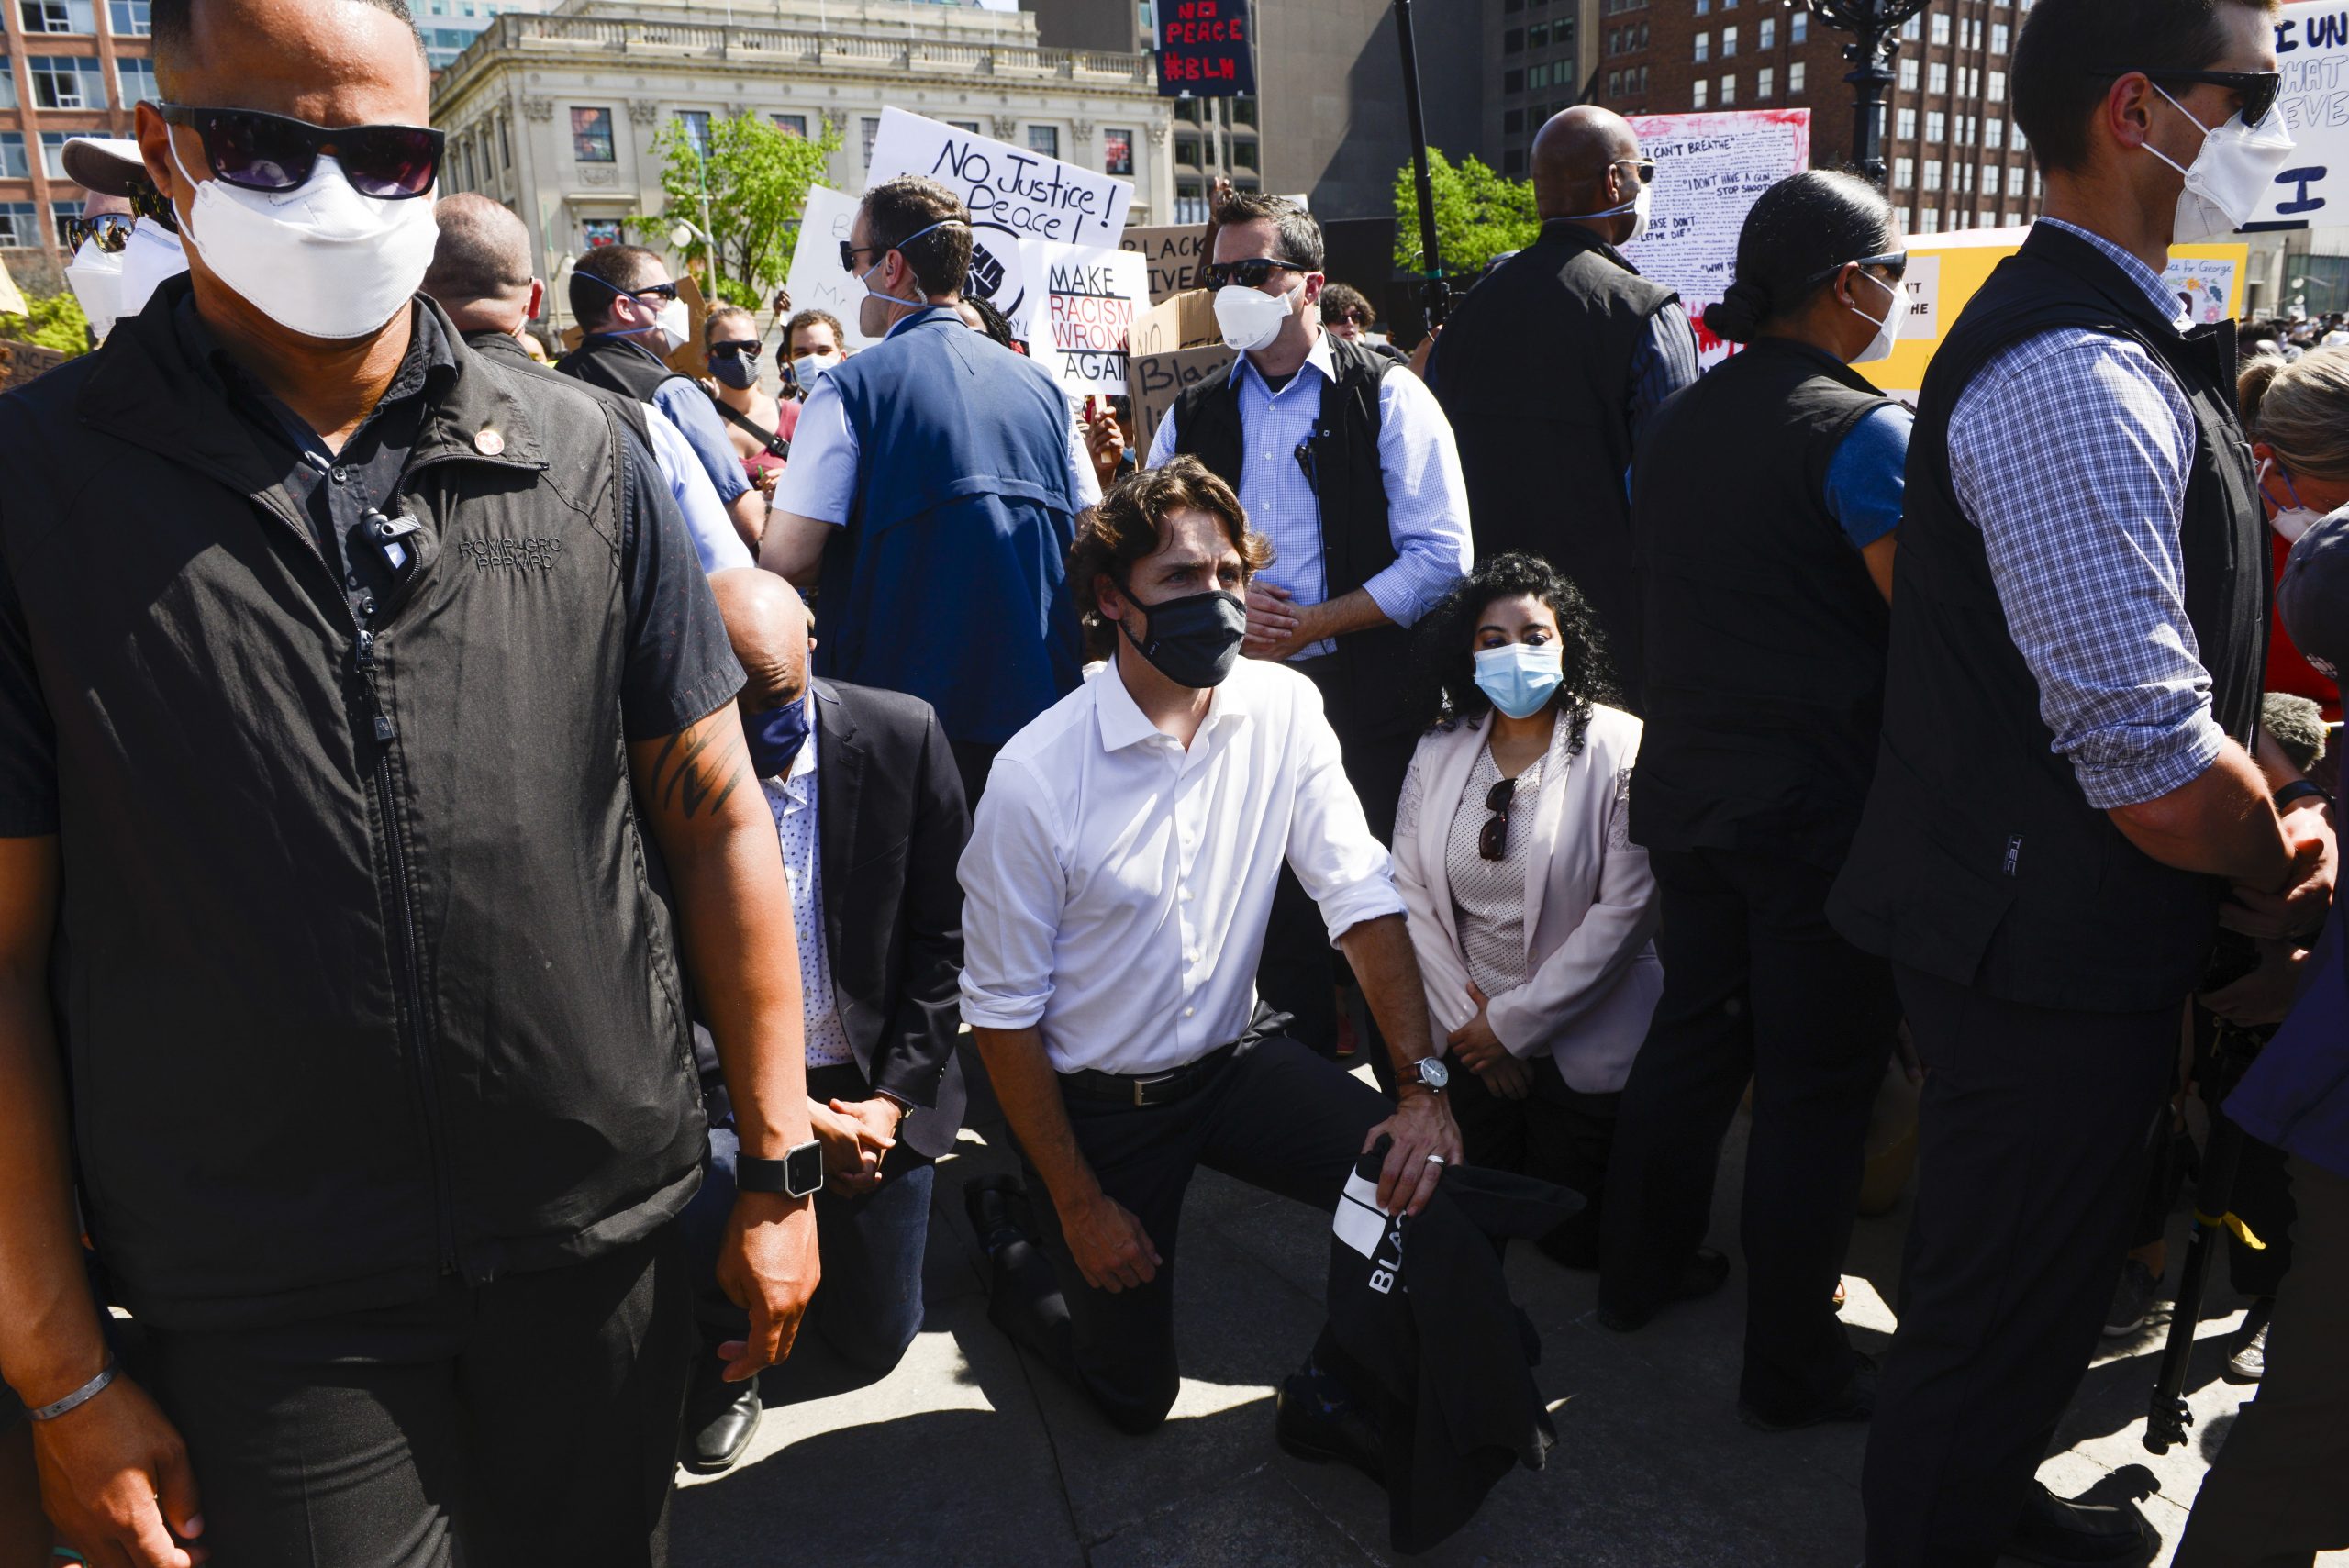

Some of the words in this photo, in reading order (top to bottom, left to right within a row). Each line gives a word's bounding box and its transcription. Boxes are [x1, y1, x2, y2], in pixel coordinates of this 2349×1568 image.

[1178, 1, 1217, 19] NO
[1166, 18, 1243, 44] PEACE
[1163, 51, 1236, 81] #BLM
[2278, 54, 2349, 94] HAT
[2279, 91, 2349, 130] EVE
[931, 139, 990, 183] NO
[1716, 185, 1739, 196] STOP
[1721, 172, 1740, 184] HAVE
[1641, 232, 1653, 242] LET
[1049, 261, 1115, 296] MAKE
[2199, 260, 2232, 276] George
[1050, 295, 1134, 326] RACISM
[2007, 838, 2021, 873] TEC
